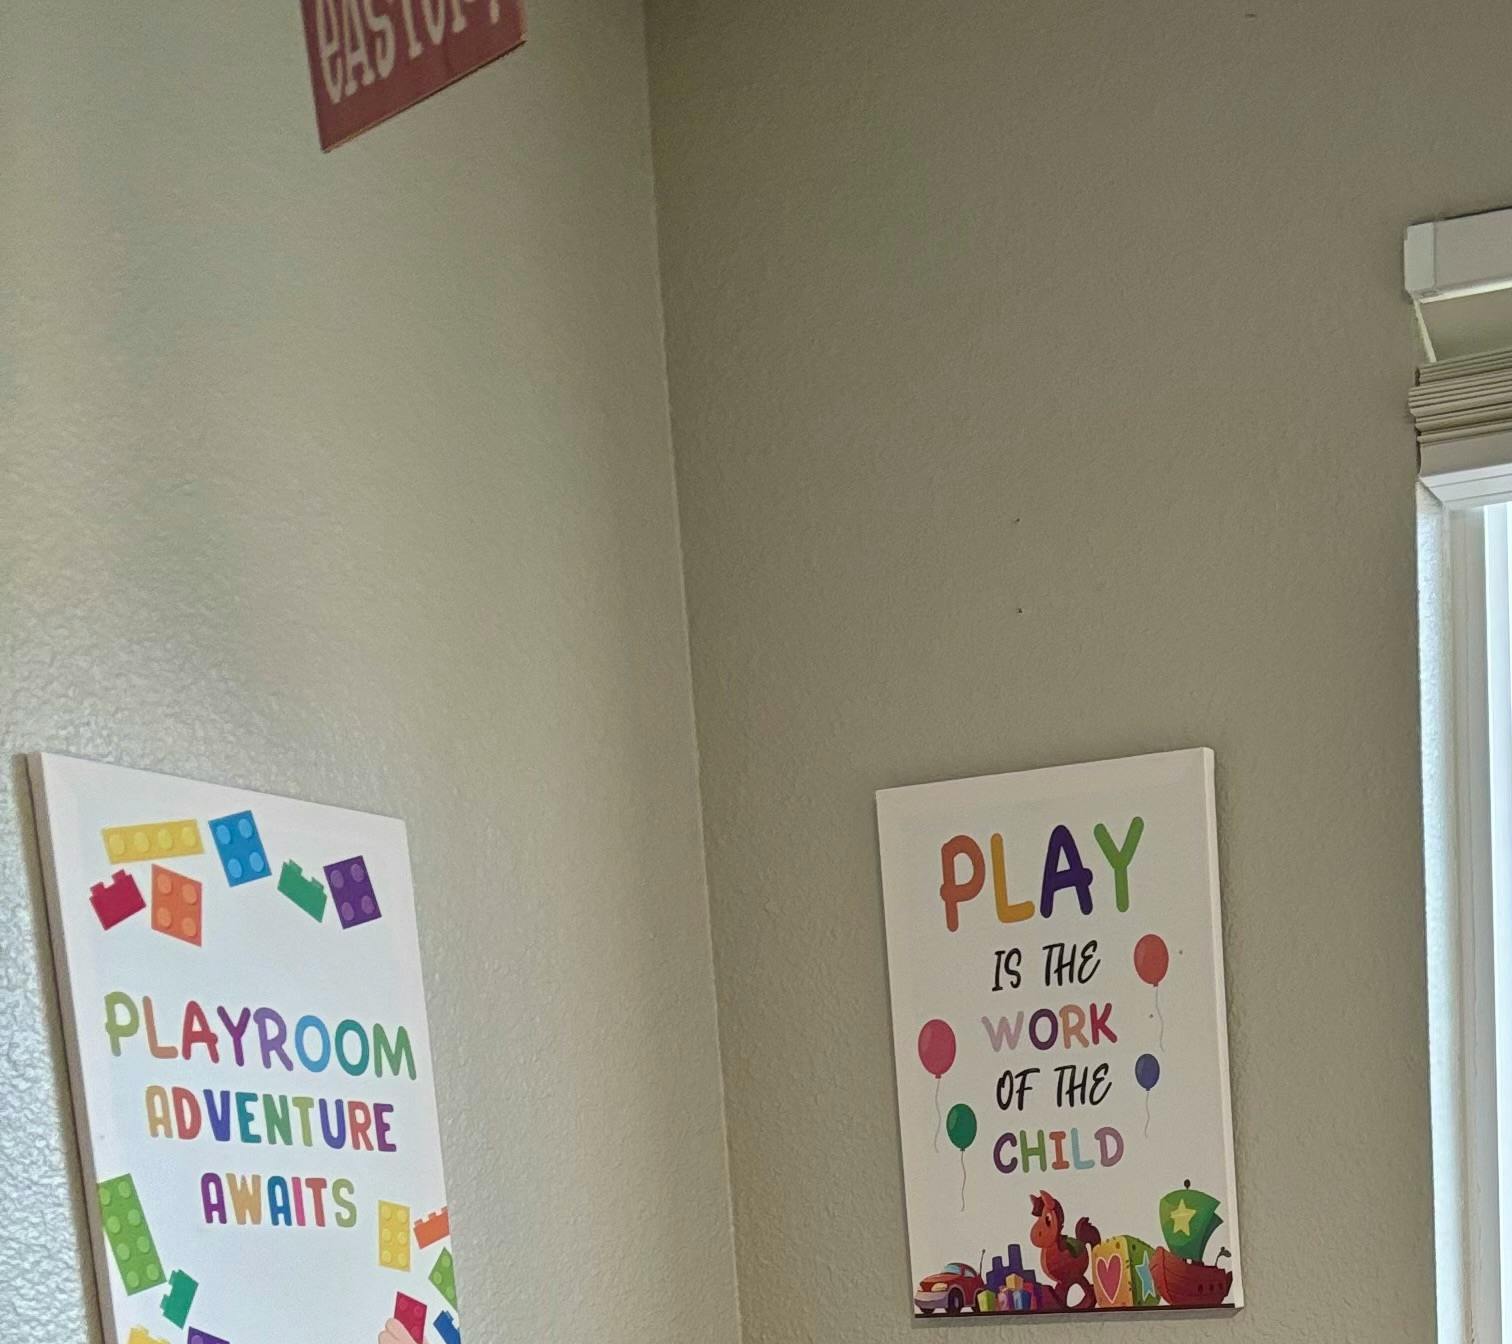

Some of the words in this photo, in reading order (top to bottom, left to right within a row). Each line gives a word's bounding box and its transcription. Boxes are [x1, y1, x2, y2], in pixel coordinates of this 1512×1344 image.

[940, 816, 1144, 932] PLAY
[991, 947, 1022, 991] IS
[1042, 940, 1101, 986] THE
[104, 991, 417, 1080] PLAYROOM
[981, 1003, 1118, 1052] WORK
[996, 1067, 1040, 1110] OF
[1054, 1063, 1112, 1107] THE
[145, 1085, 397, 1152] ADVENTURE
[993, 1127, 1124, 1173] CHILD
[200, 1171, 357, 1227] AWAITS
